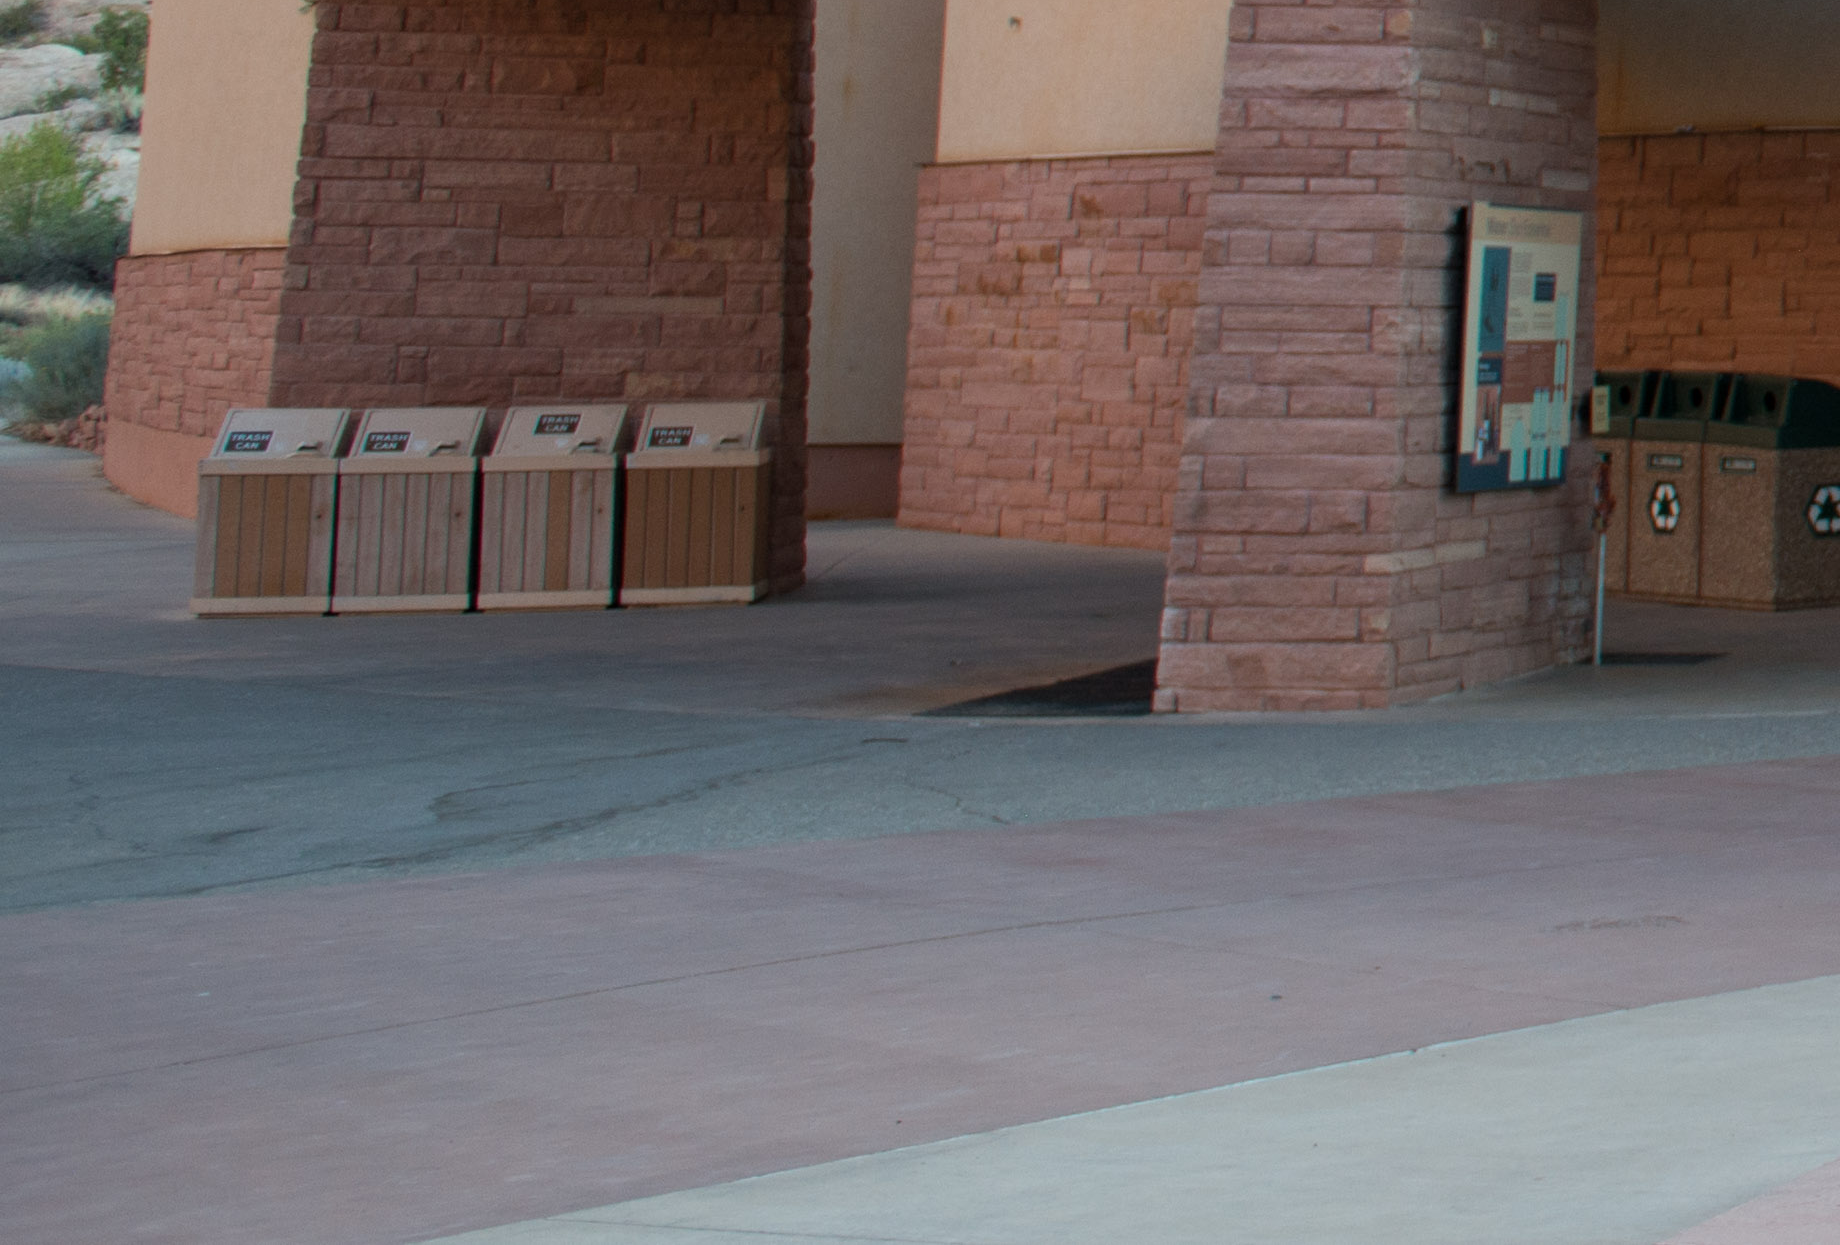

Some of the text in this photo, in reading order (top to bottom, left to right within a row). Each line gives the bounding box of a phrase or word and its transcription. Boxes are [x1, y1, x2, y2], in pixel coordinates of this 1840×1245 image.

[541, 416, 578, 424] TRASH
[544, 424, 569, 432] CAN
[370, 433, 408, 441] TRASH
[654, 429, 691, 437] TRASH
[232, 434, 271, 442] TRASH
[658, 437, 682, 445] CAN
[373, 441, 398, 449] CAN
